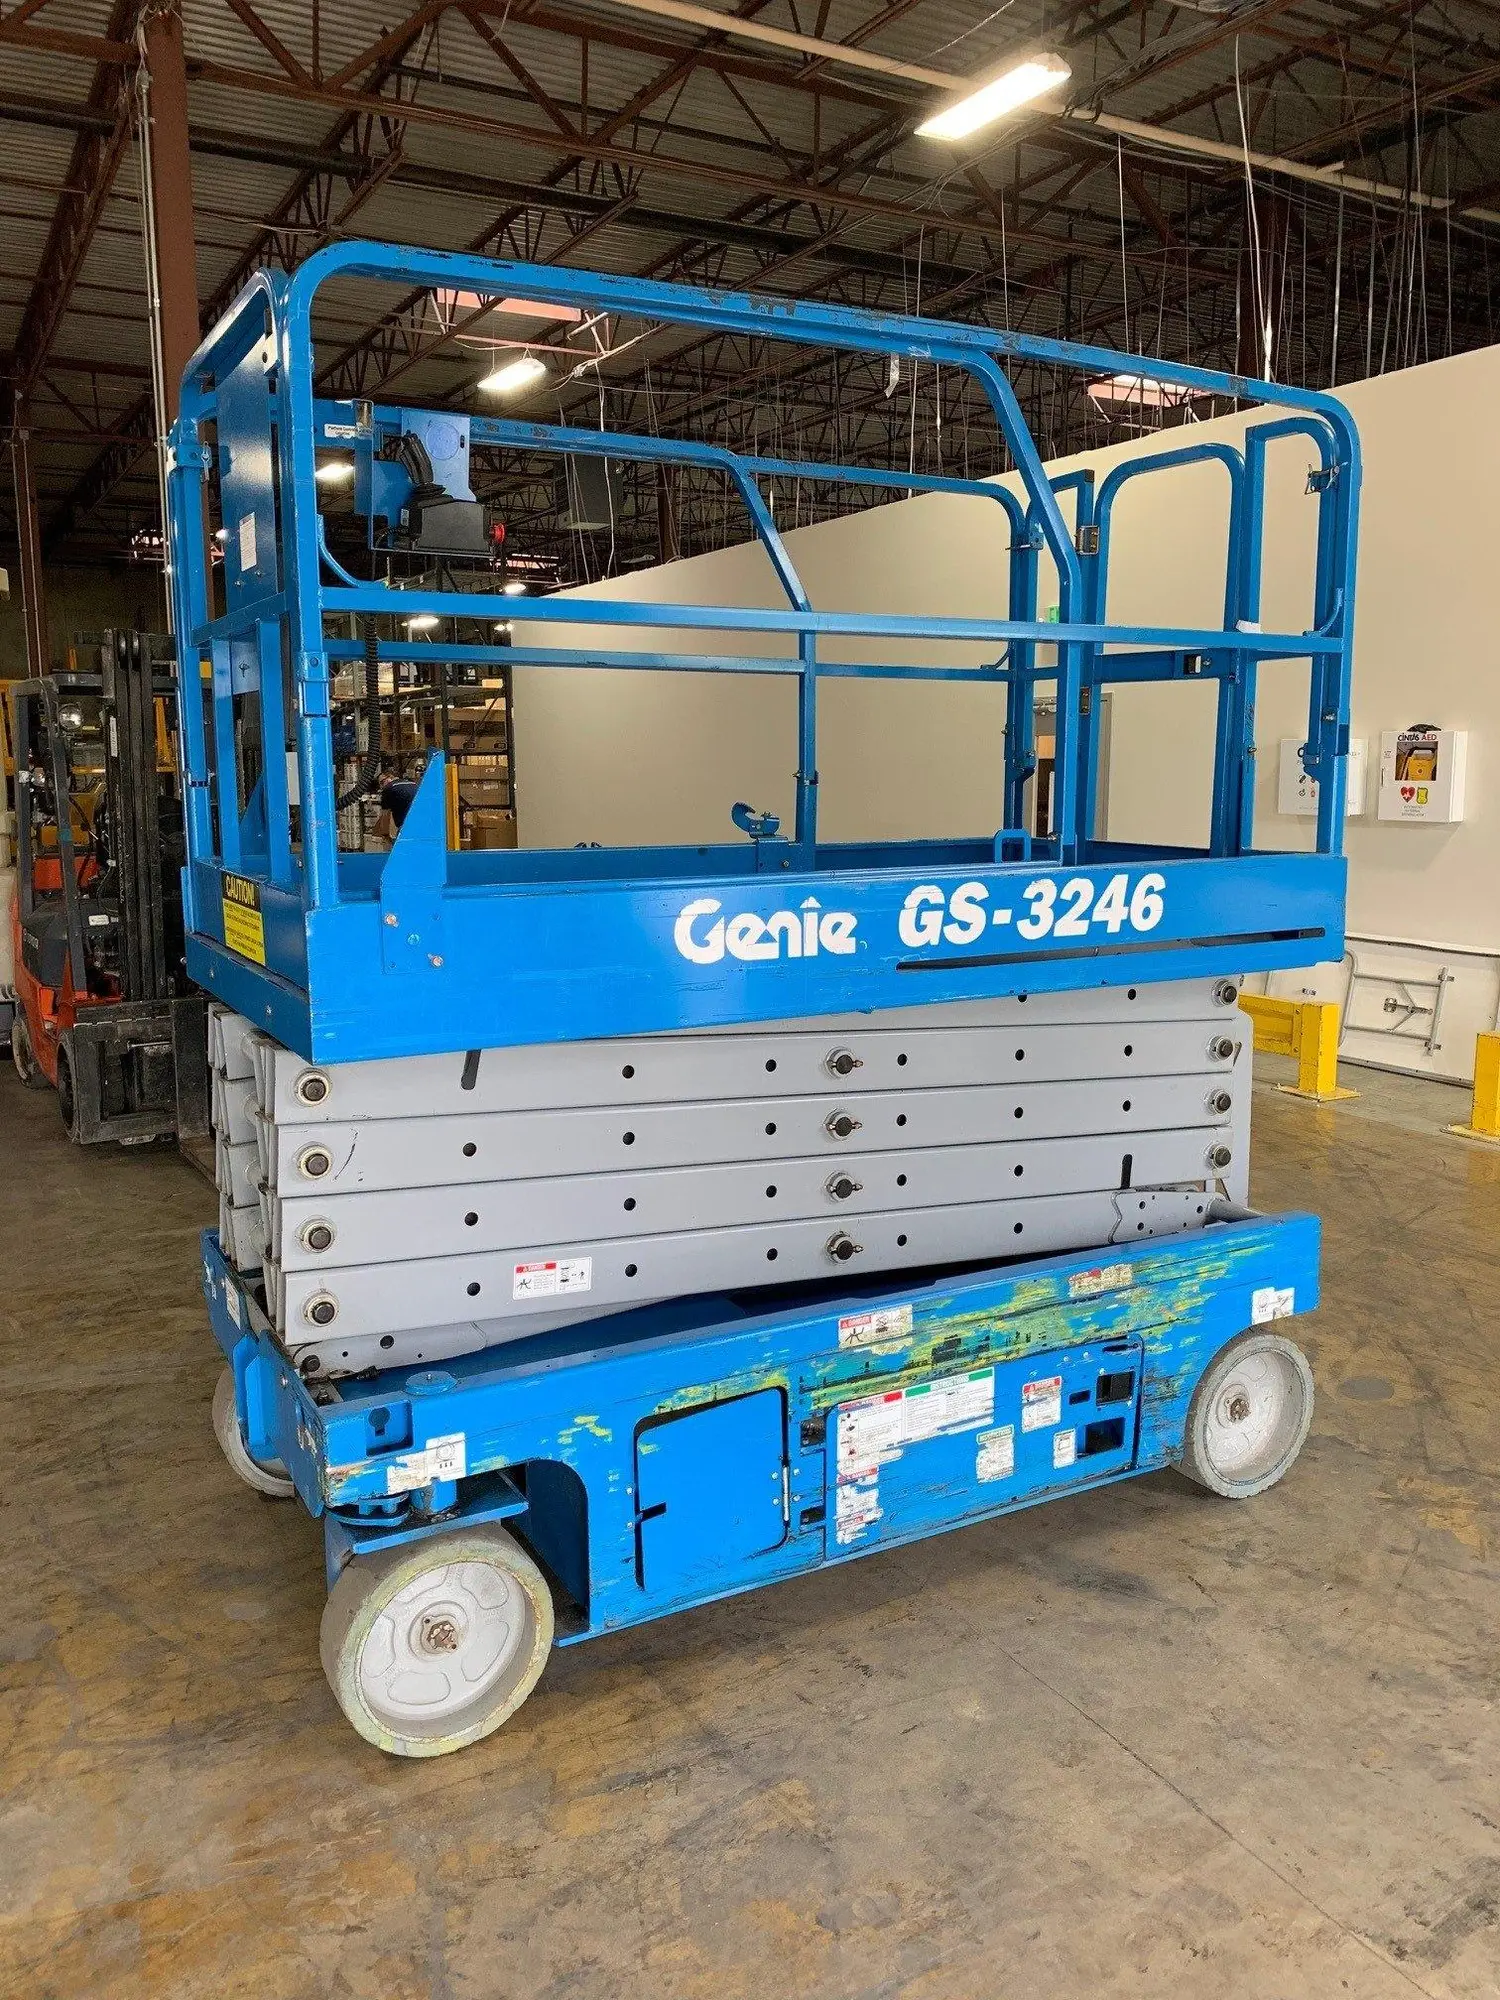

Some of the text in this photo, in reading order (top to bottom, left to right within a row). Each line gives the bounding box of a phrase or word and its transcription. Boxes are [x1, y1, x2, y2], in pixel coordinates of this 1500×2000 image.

[1421, 733, 1438, 741] AED
[674, 873, 1167, 965] Genie GS-3246
